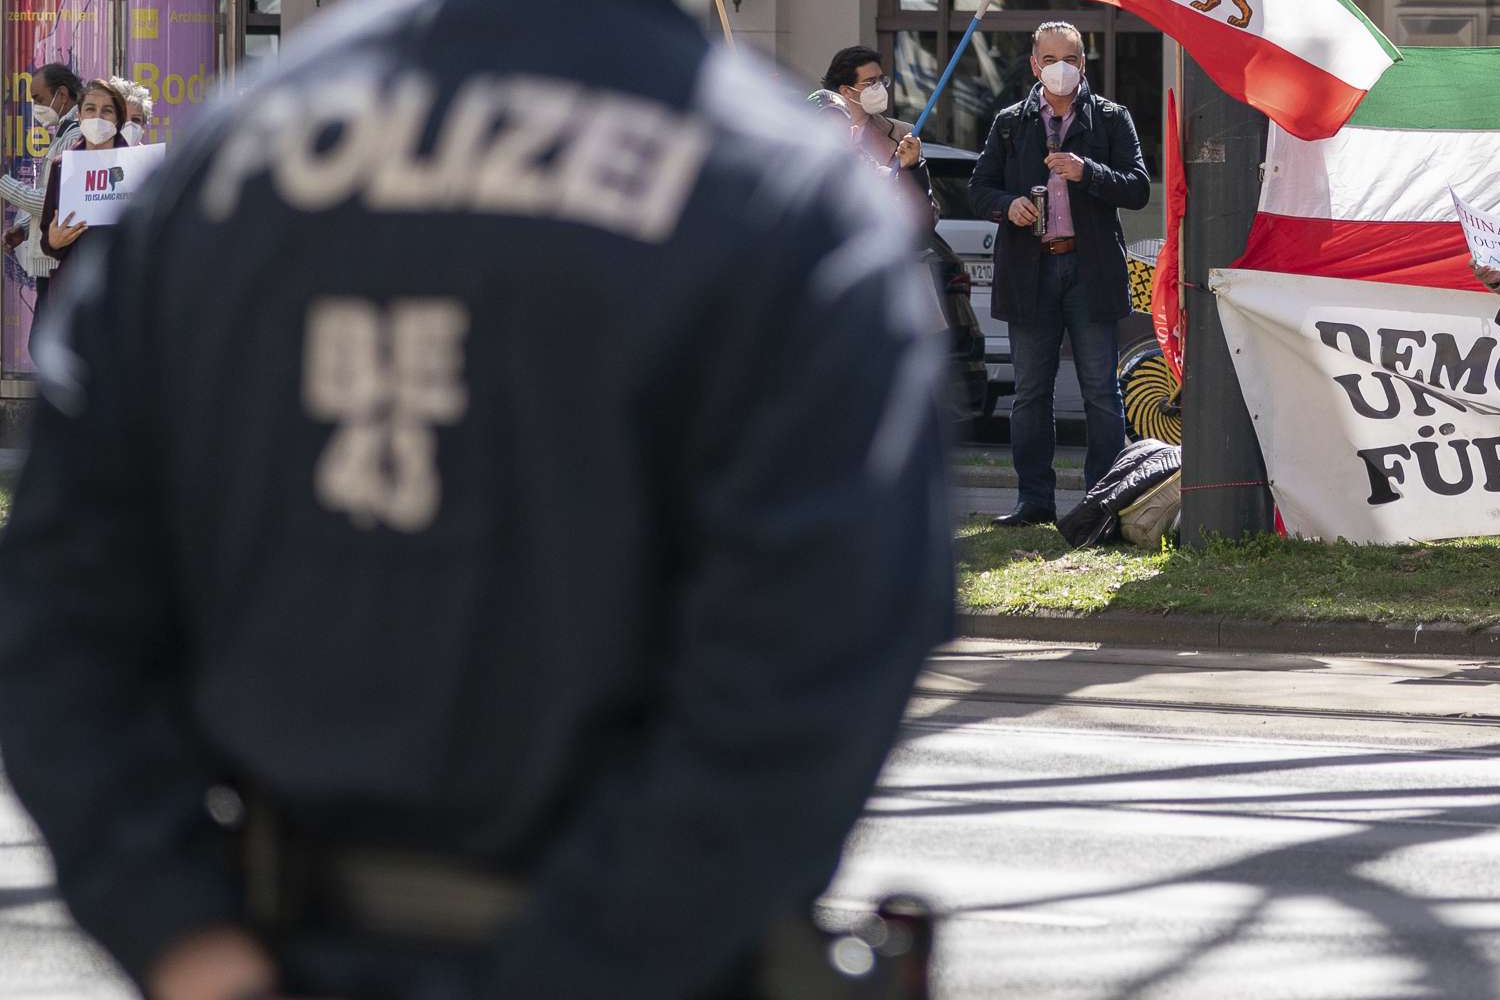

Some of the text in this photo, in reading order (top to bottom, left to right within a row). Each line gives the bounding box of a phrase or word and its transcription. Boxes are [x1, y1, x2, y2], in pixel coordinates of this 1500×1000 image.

[203, 76, 710, 244] POLIZEI
[85, 170, 107, 191] NO
[93, 193, 115, 201] ISLAMIC
